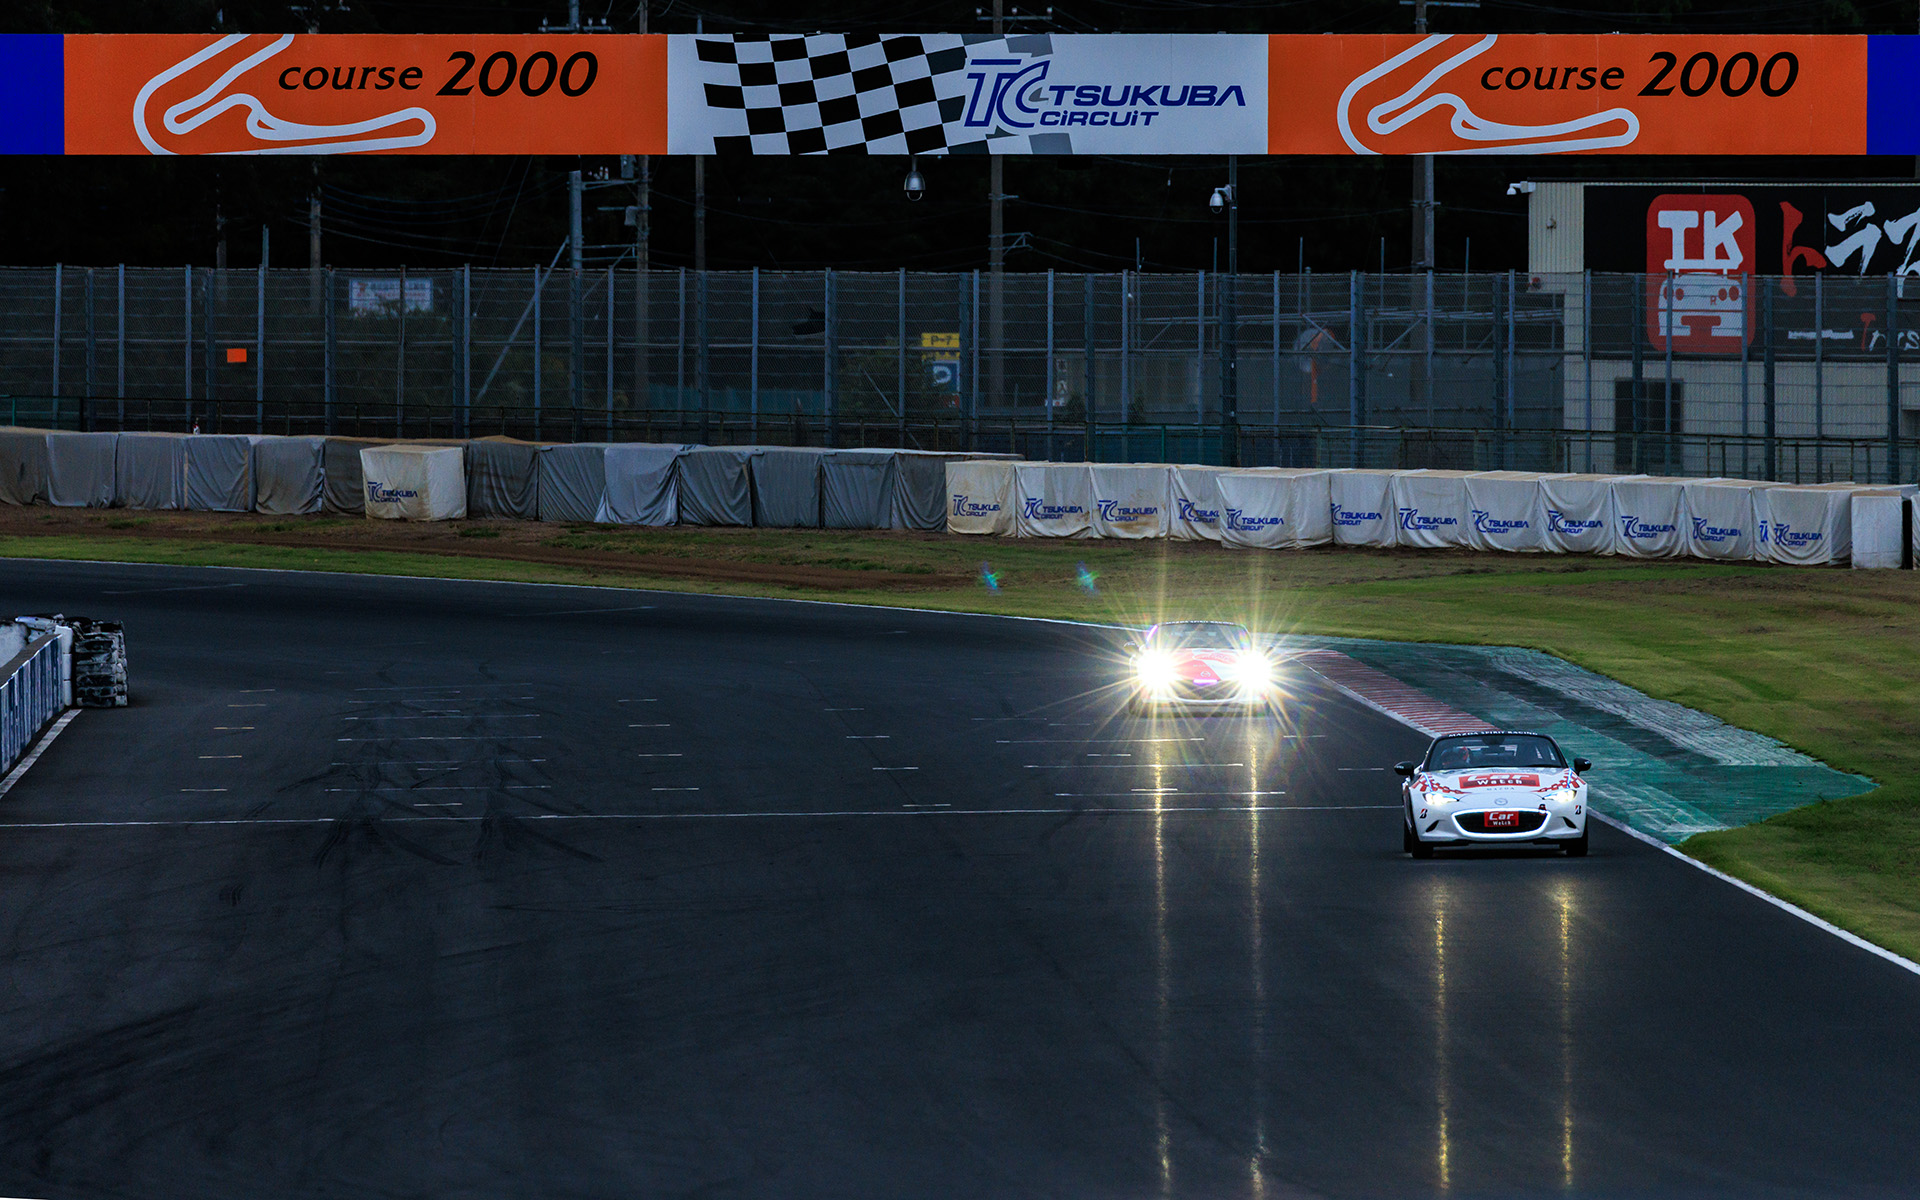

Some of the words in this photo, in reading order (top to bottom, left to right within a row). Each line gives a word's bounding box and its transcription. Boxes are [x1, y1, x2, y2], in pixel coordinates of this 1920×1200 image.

[279, 67, 423, 91] course
[436, 51, 599, 98] 2000
[1481, 67, 1625, 91] course
[1638, 51, 1799, 98] 2000
[1048, 85, 1246, 106] TSUKUBA
[1657, 210, 1743, 269] TK
[1042, 506, 1083, 514] TSUKUBA
[1117, 507, 1158, 515] TSUKUBA
[1340, 511, 1382, 520] TSUKUBA
[1241, 517, 1284, 525] TSUKUBA
[1416, 517, 1457, 525] TSUKUBA
[1488, 520, 1529, 528] TSUKUBA
[1564, 520, 1603, 528] TSUKUBA
[1638, 524, 1676, 532] TSUKUBA
[1789, 532, 1823, 541] TSUKUBA
[1489, 812, 1514, 820] Car
